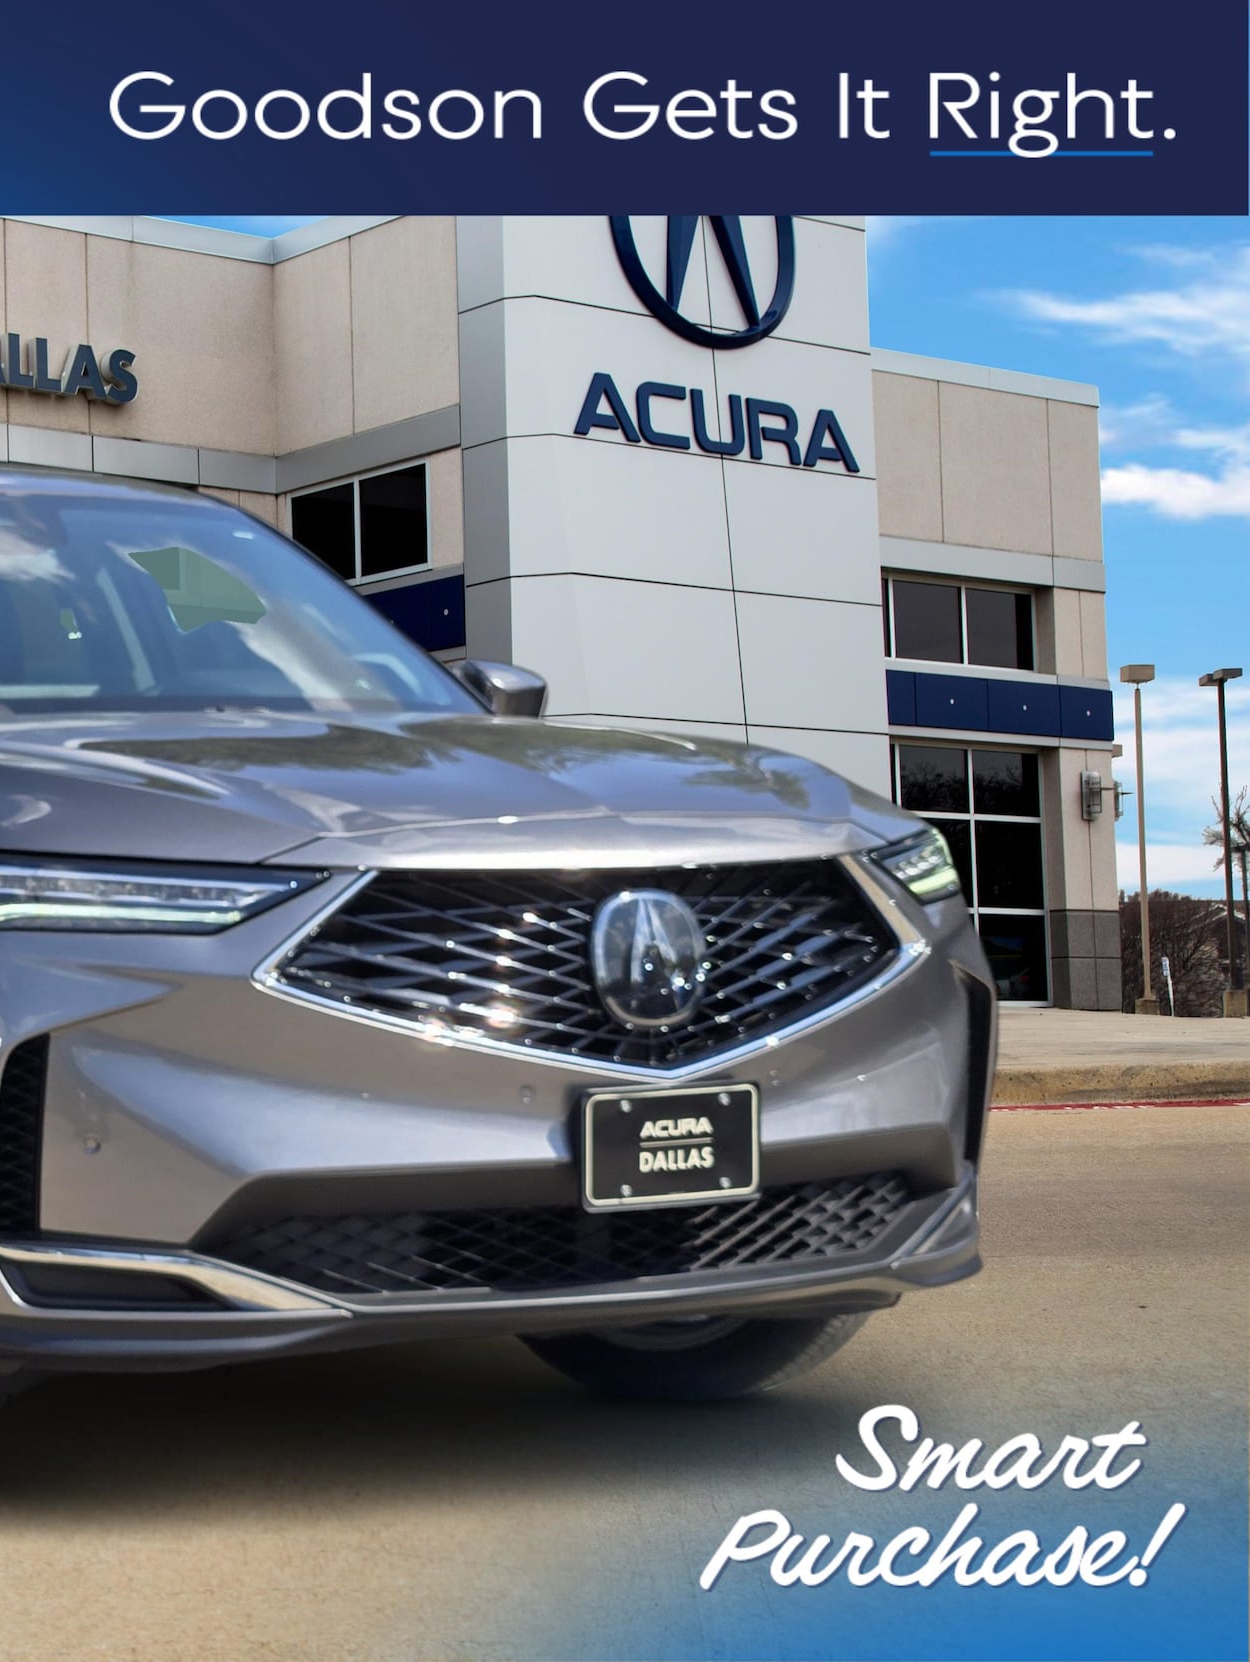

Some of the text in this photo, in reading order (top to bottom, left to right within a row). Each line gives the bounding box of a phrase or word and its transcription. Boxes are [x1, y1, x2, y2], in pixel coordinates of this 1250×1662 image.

[574, 372, 859, 473] ACURA
[639, 1116, 714, 1139] ACURA
[638, 1146, 715, 1173] DALLAS
